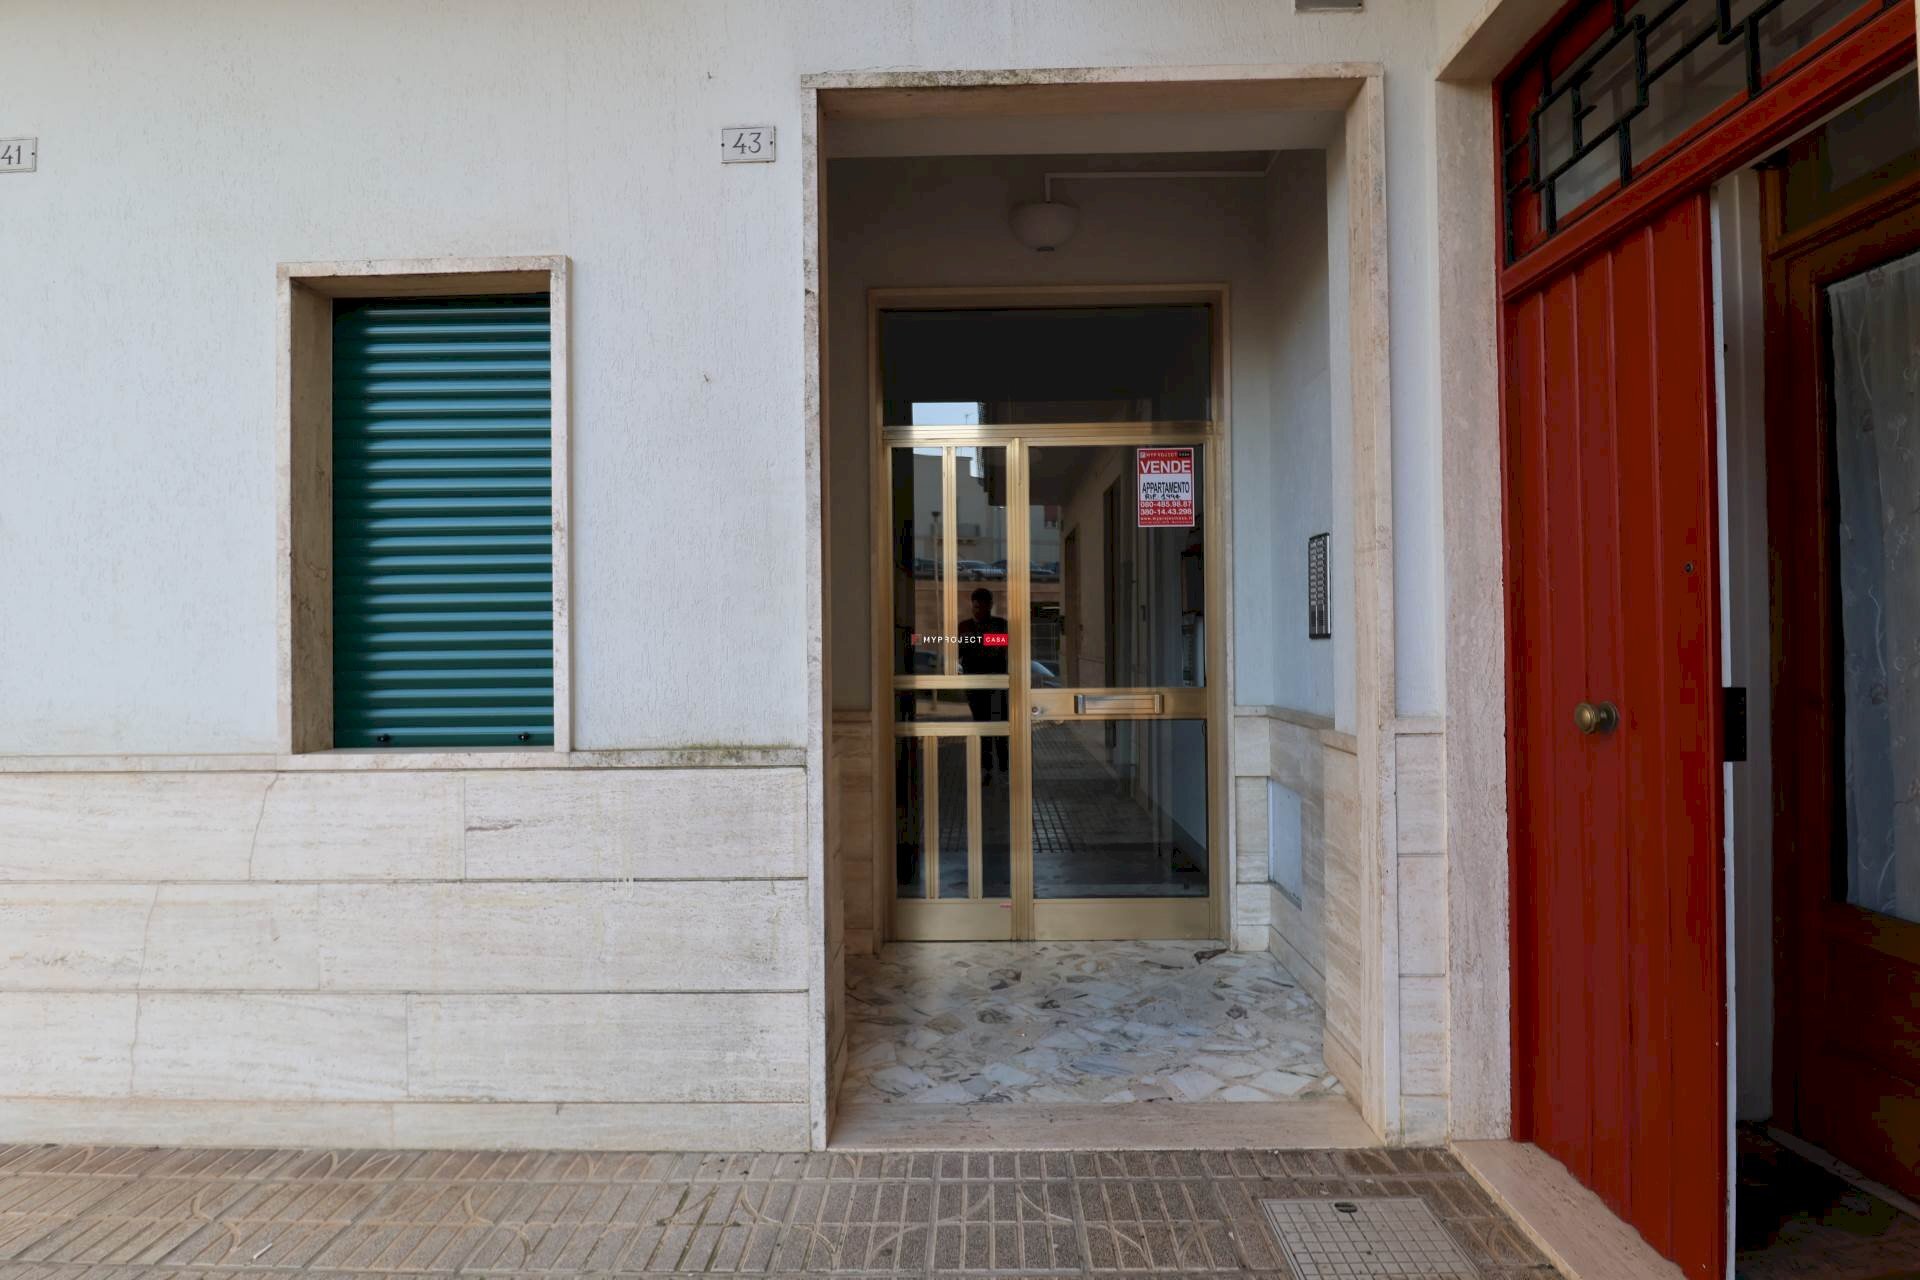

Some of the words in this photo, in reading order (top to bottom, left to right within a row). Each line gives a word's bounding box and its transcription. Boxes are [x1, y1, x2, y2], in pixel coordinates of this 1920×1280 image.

[732, 132, 762, 154] 43
[1, 145, 22, 165] 41
[1140, 460, 1191, 474] VENDE
[1142, 482, 1190, 494] APPARTAMENTO
